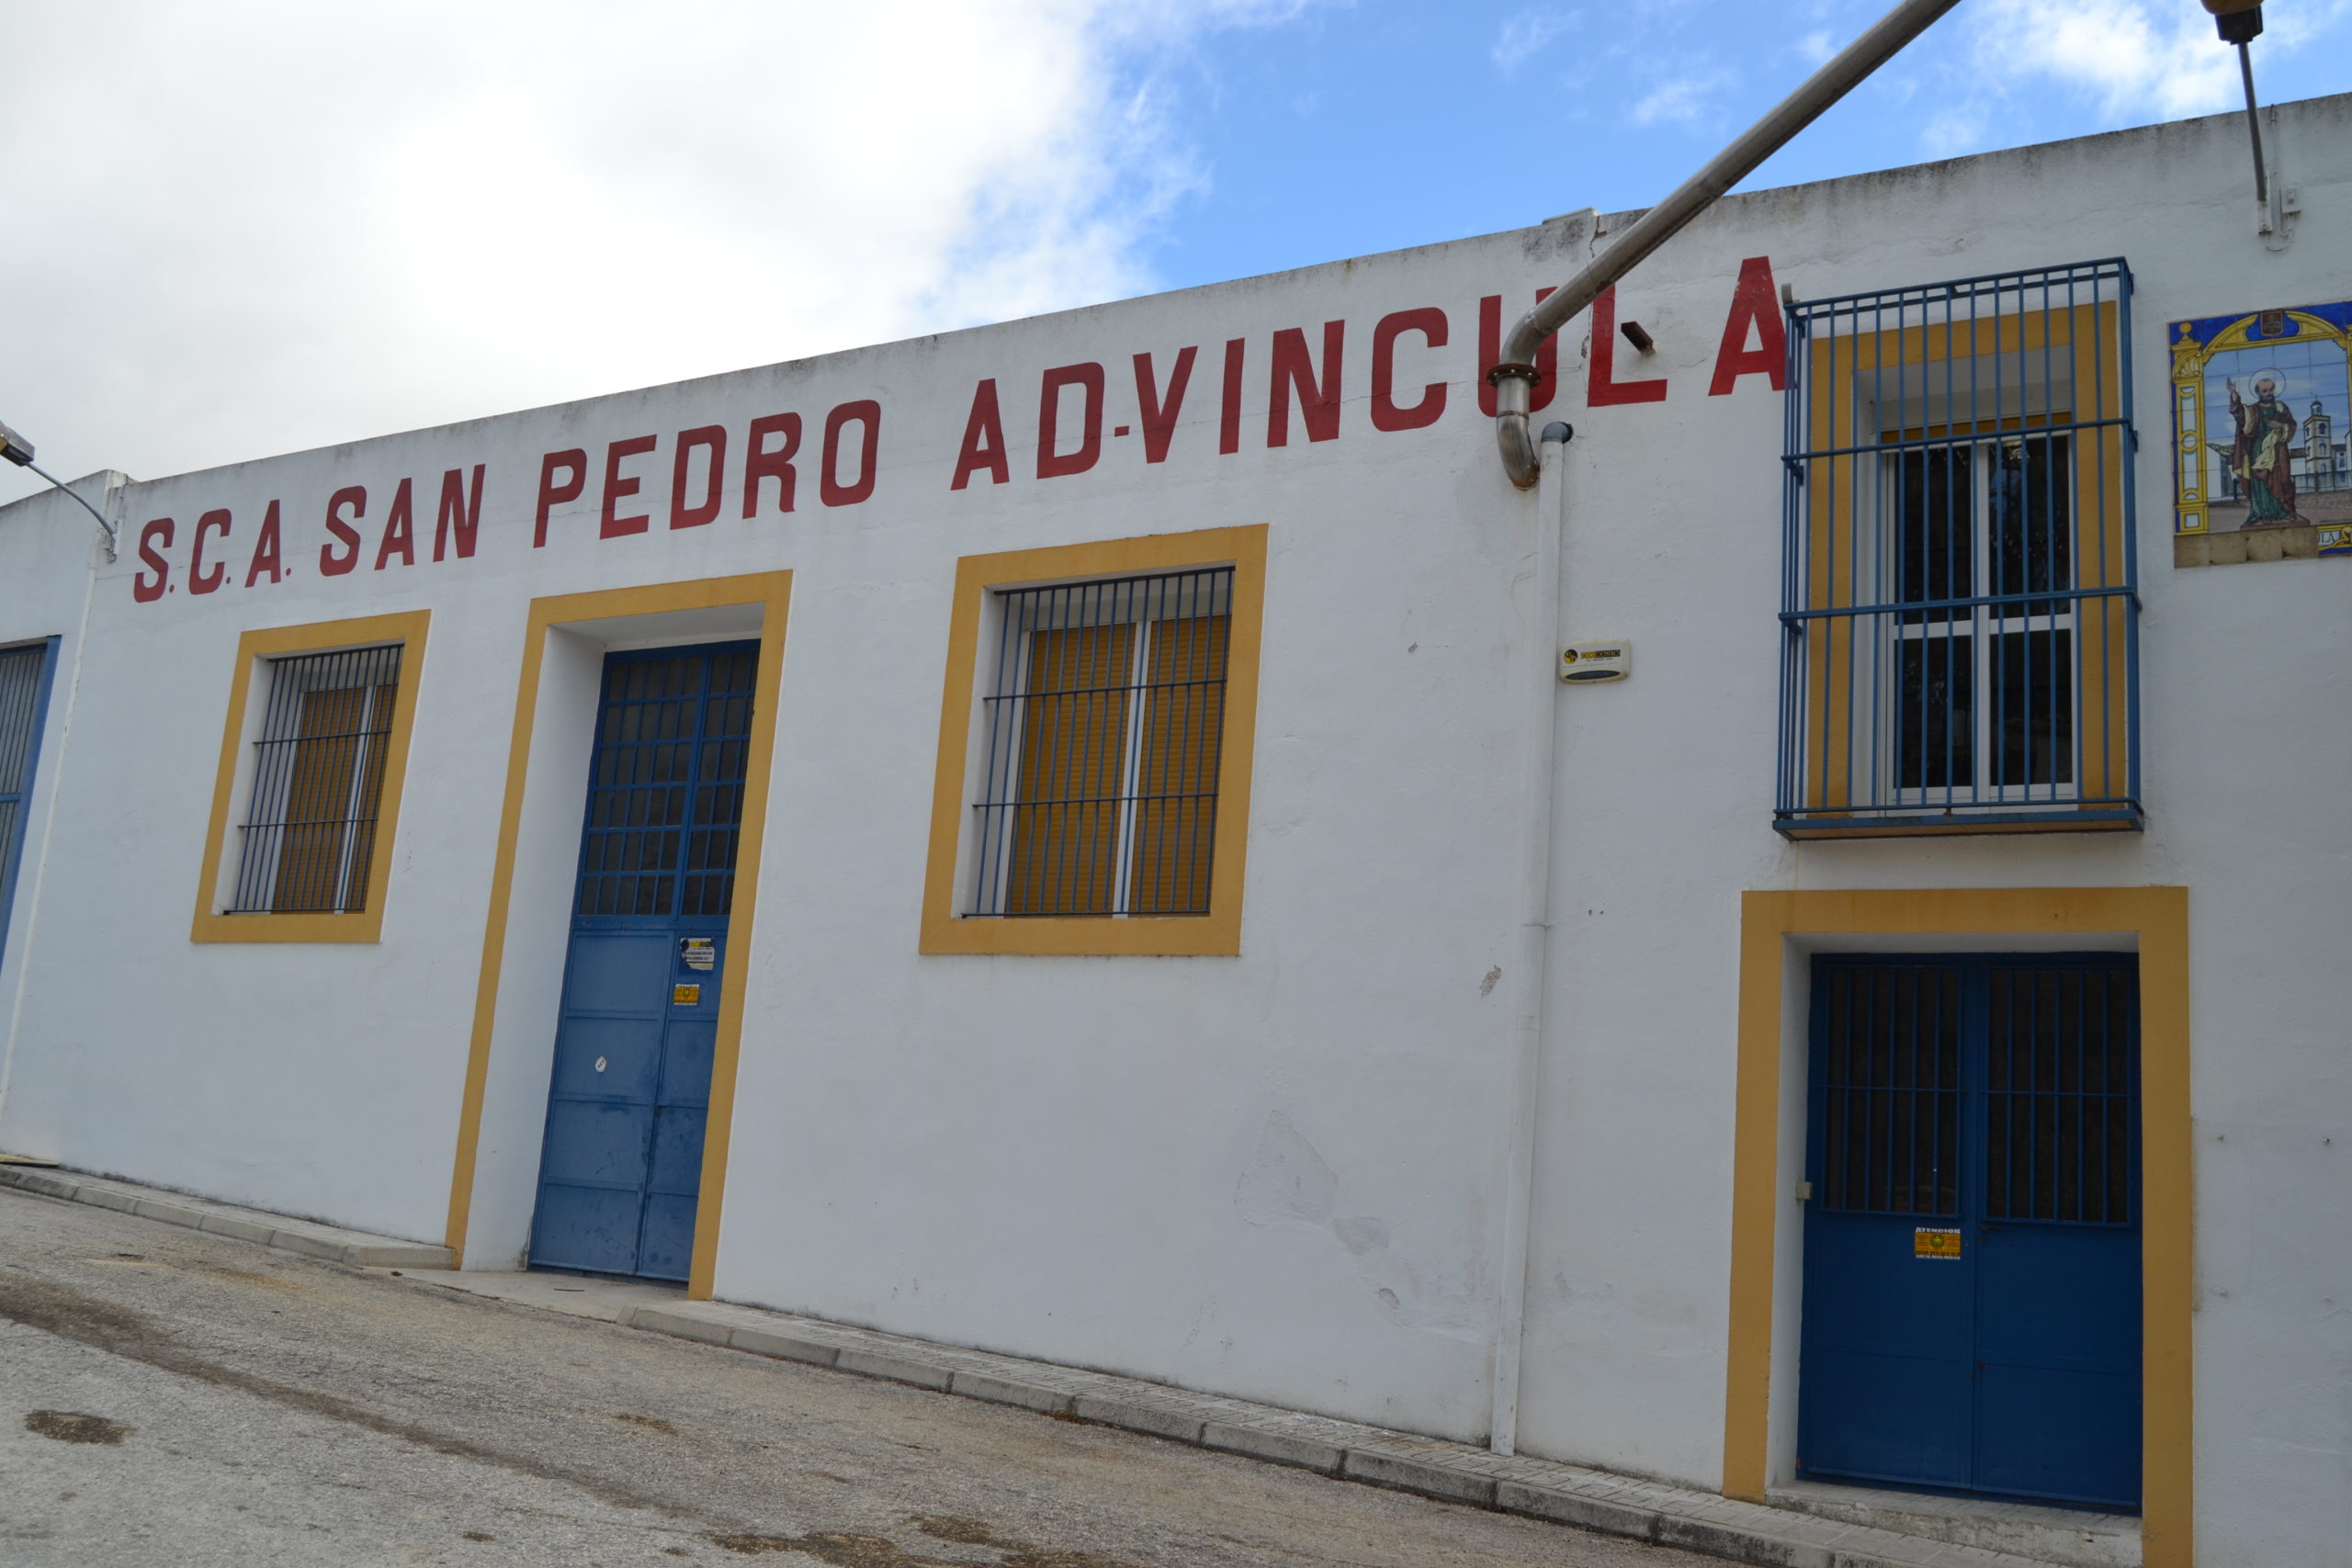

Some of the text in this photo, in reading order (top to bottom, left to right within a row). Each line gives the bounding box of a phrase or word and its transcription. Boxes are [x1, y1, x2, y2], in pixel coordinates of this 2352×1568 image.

[133, 500, 292, 604] S.C.A.
[320, 464, 486, 577] SAN
[534, 400, 879, 547] PEDRO
